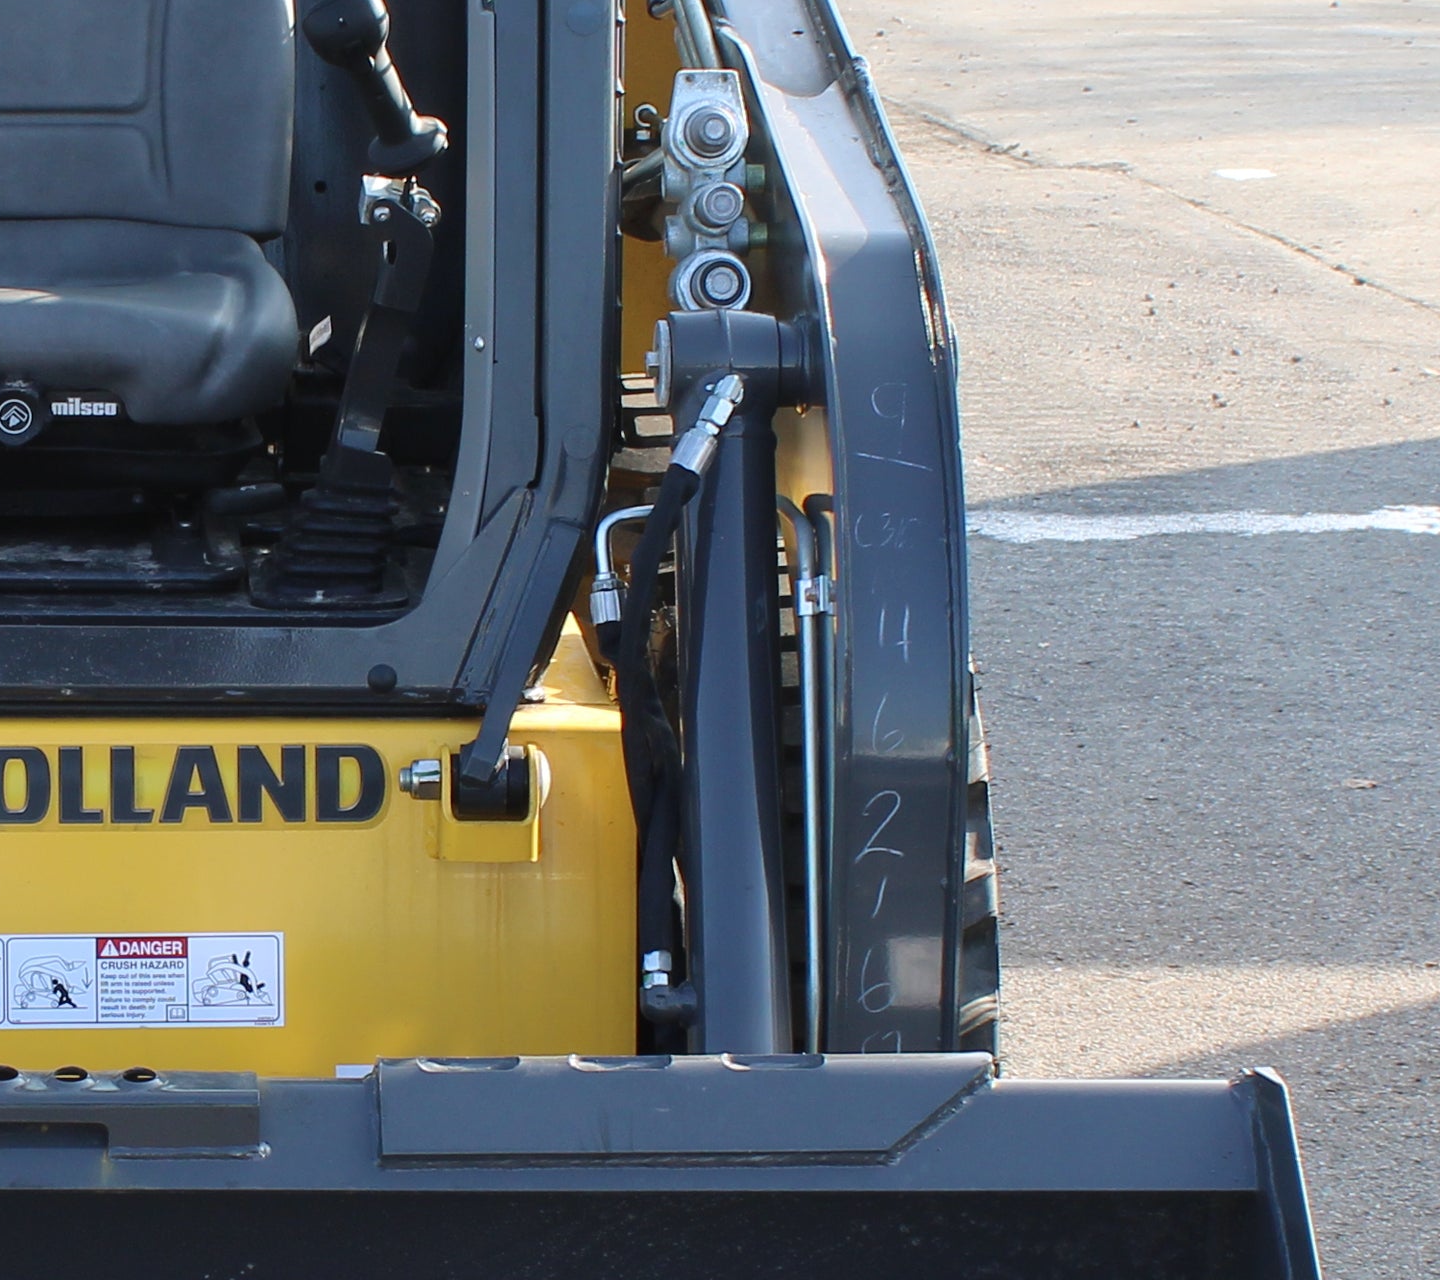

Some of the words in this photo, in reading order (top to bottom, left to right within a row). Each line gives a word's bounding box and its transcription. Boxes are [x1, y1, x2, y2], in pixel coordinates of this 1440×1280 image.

[51, 397, 118, 417] milsco
[119, 940, 183, 956] DANGER
[100, 961, 137, 970] CRUSH
[140, 960, 184, 969] HAZARD
